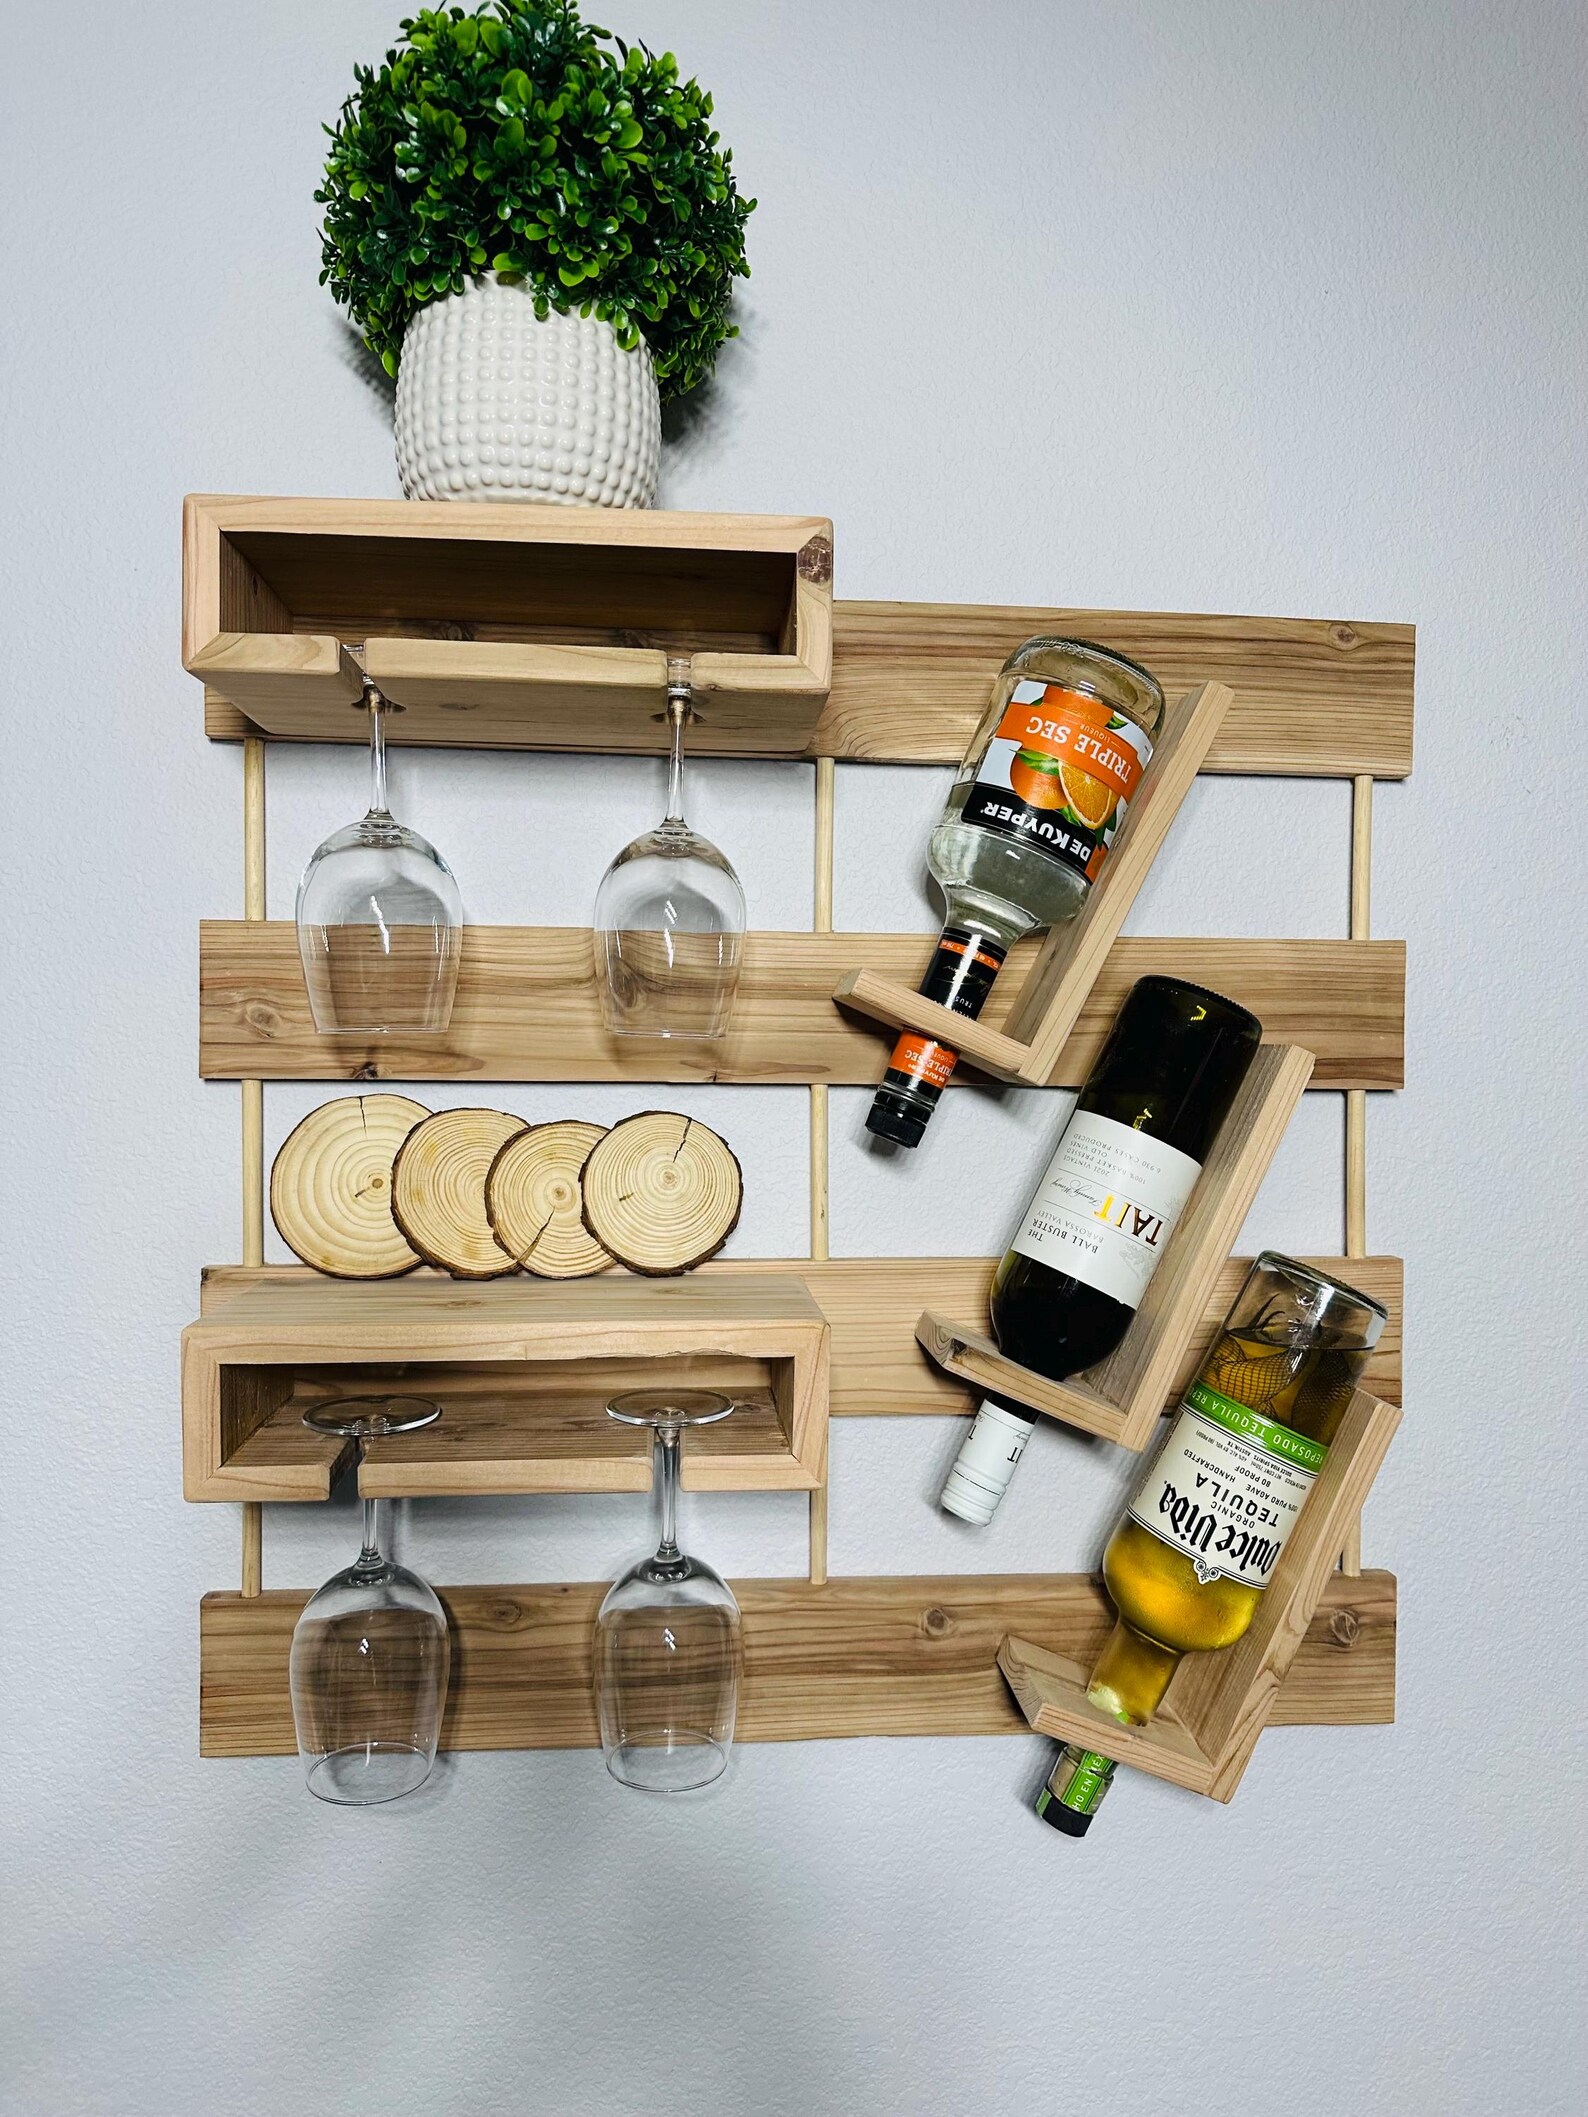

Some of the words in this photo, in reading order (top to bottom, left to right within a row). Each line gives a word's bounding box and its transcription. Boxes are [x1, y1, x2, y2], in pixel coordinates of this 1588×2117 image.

[1024, 715, 1071, 743] SEC
[1079, 722, 1110, 743] LIQUEUR
[1072, 732, 1132, 783] TRIPLE
[903, 1048, 924, 1064] SEC
[1069, 1139, 1089, 1151] VINES
[1072, 1131, 1112, 1151] PRODUCED
[1062, 1153, 1091, 1169] VINTAGE
[1066, 1146, 1094, 1161] PRESSED
[1089, 1146, 1107, 1159] OLD
[1113, 1147, 1140, 1163] CASES
[1091, 1164, 1110, 1176] 2021
[1096, 1157, 1127, 1175] BASKET
[1036, 1208, 1061, 1224] VALLEY
[1091, 1191, 1163, 1246] TAIT
[1026, 1228, 1044, 1241] THE
[1031, 1217, 1067, 1239] BUSTER
[1063, 1219, 1104, 1244] BAROSSA
[1070, 1234, 1099, 1253] BALL
[1210, 1399, 1266, 1438] TEQUILA
[1182, 1448, 1236, 1483] HANDCRAFTED
[1252, 1454, 1270, 1467] SPIRITS
[1233, 1464, 1261, 1482] PROOF
[1260, 1477, 1272, 1487] 80
[1194, 1472, 1279, 1527] TEQUILA
[1244, 1482, 1270, 1500] AGAVE
[1269, 1495, 1288, 1508] PURO
[1209, 1499, 1255, 1529] ORGANIC
[1213, 1524, 1282, 1575] Dulce
[1079, 1777, 1093, 1793] EN
